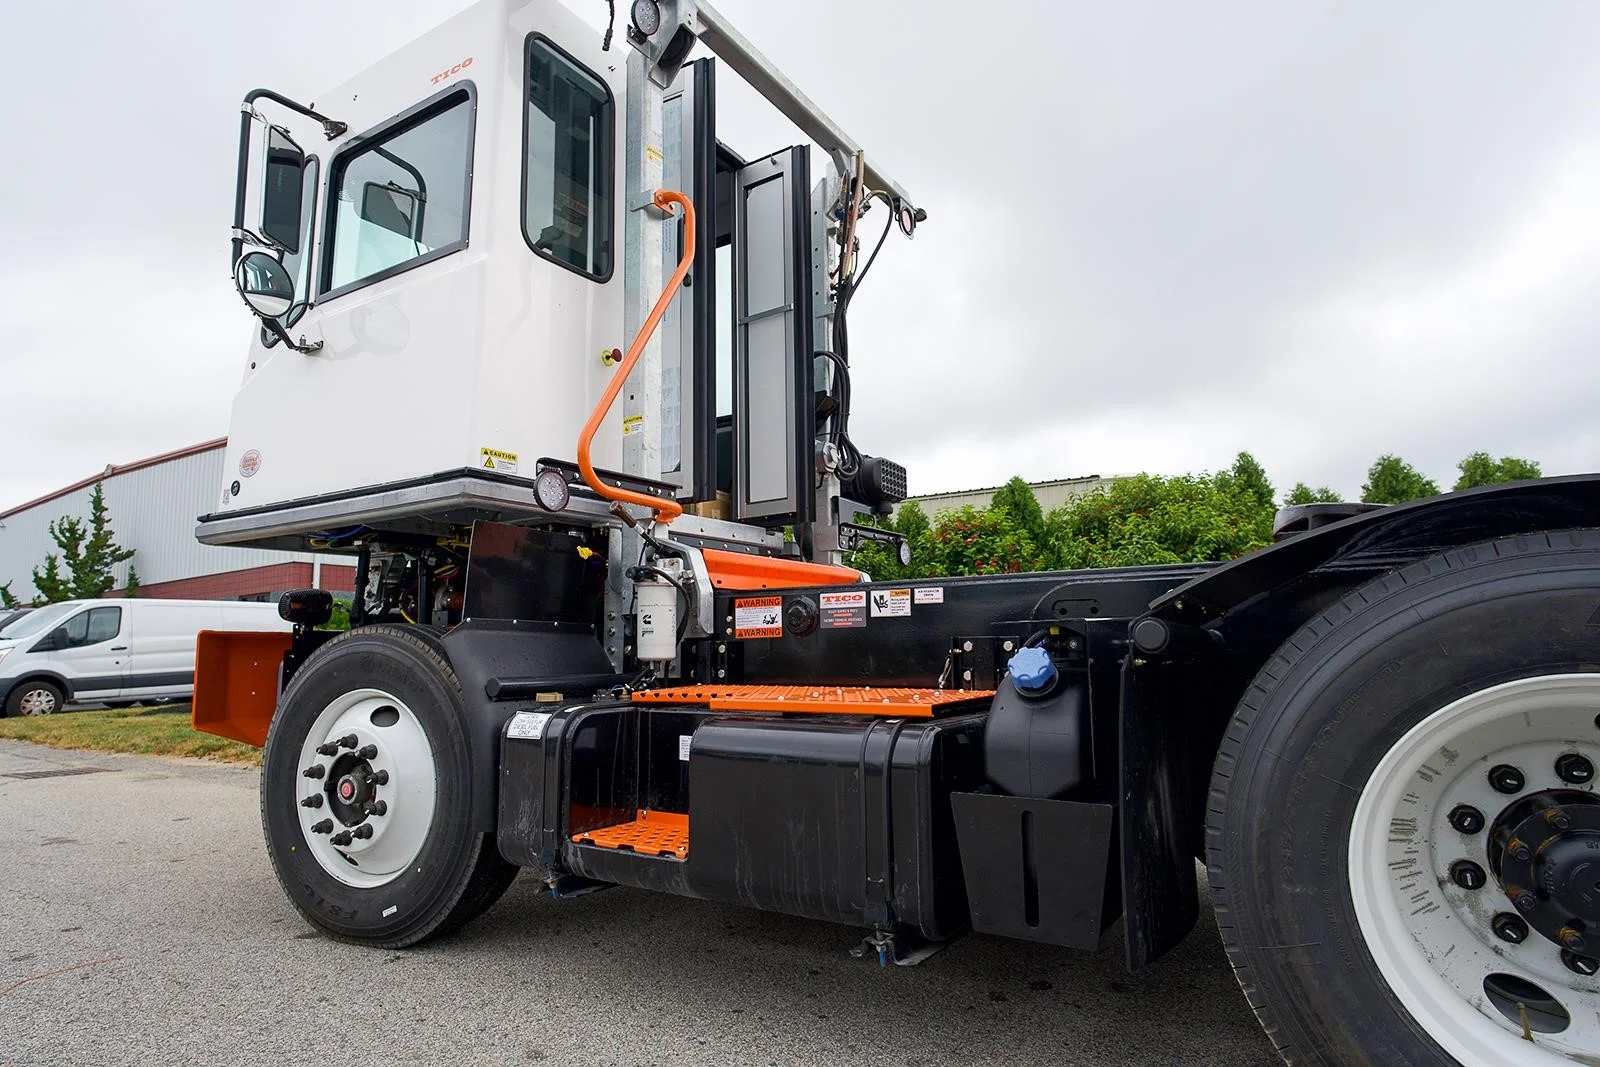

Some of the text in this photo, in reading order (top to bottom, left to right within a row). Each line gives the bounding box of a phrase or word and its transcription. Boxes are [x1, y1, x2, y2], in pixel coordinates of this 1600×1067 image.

[431, 57, 473, 85] TICO
[489, 450, 516, 461] CAUTION
[743, 597, 781, 607] WARNING
[822, 594, 864, 603] TICO
[743, 628, 781, 637] WARNING
